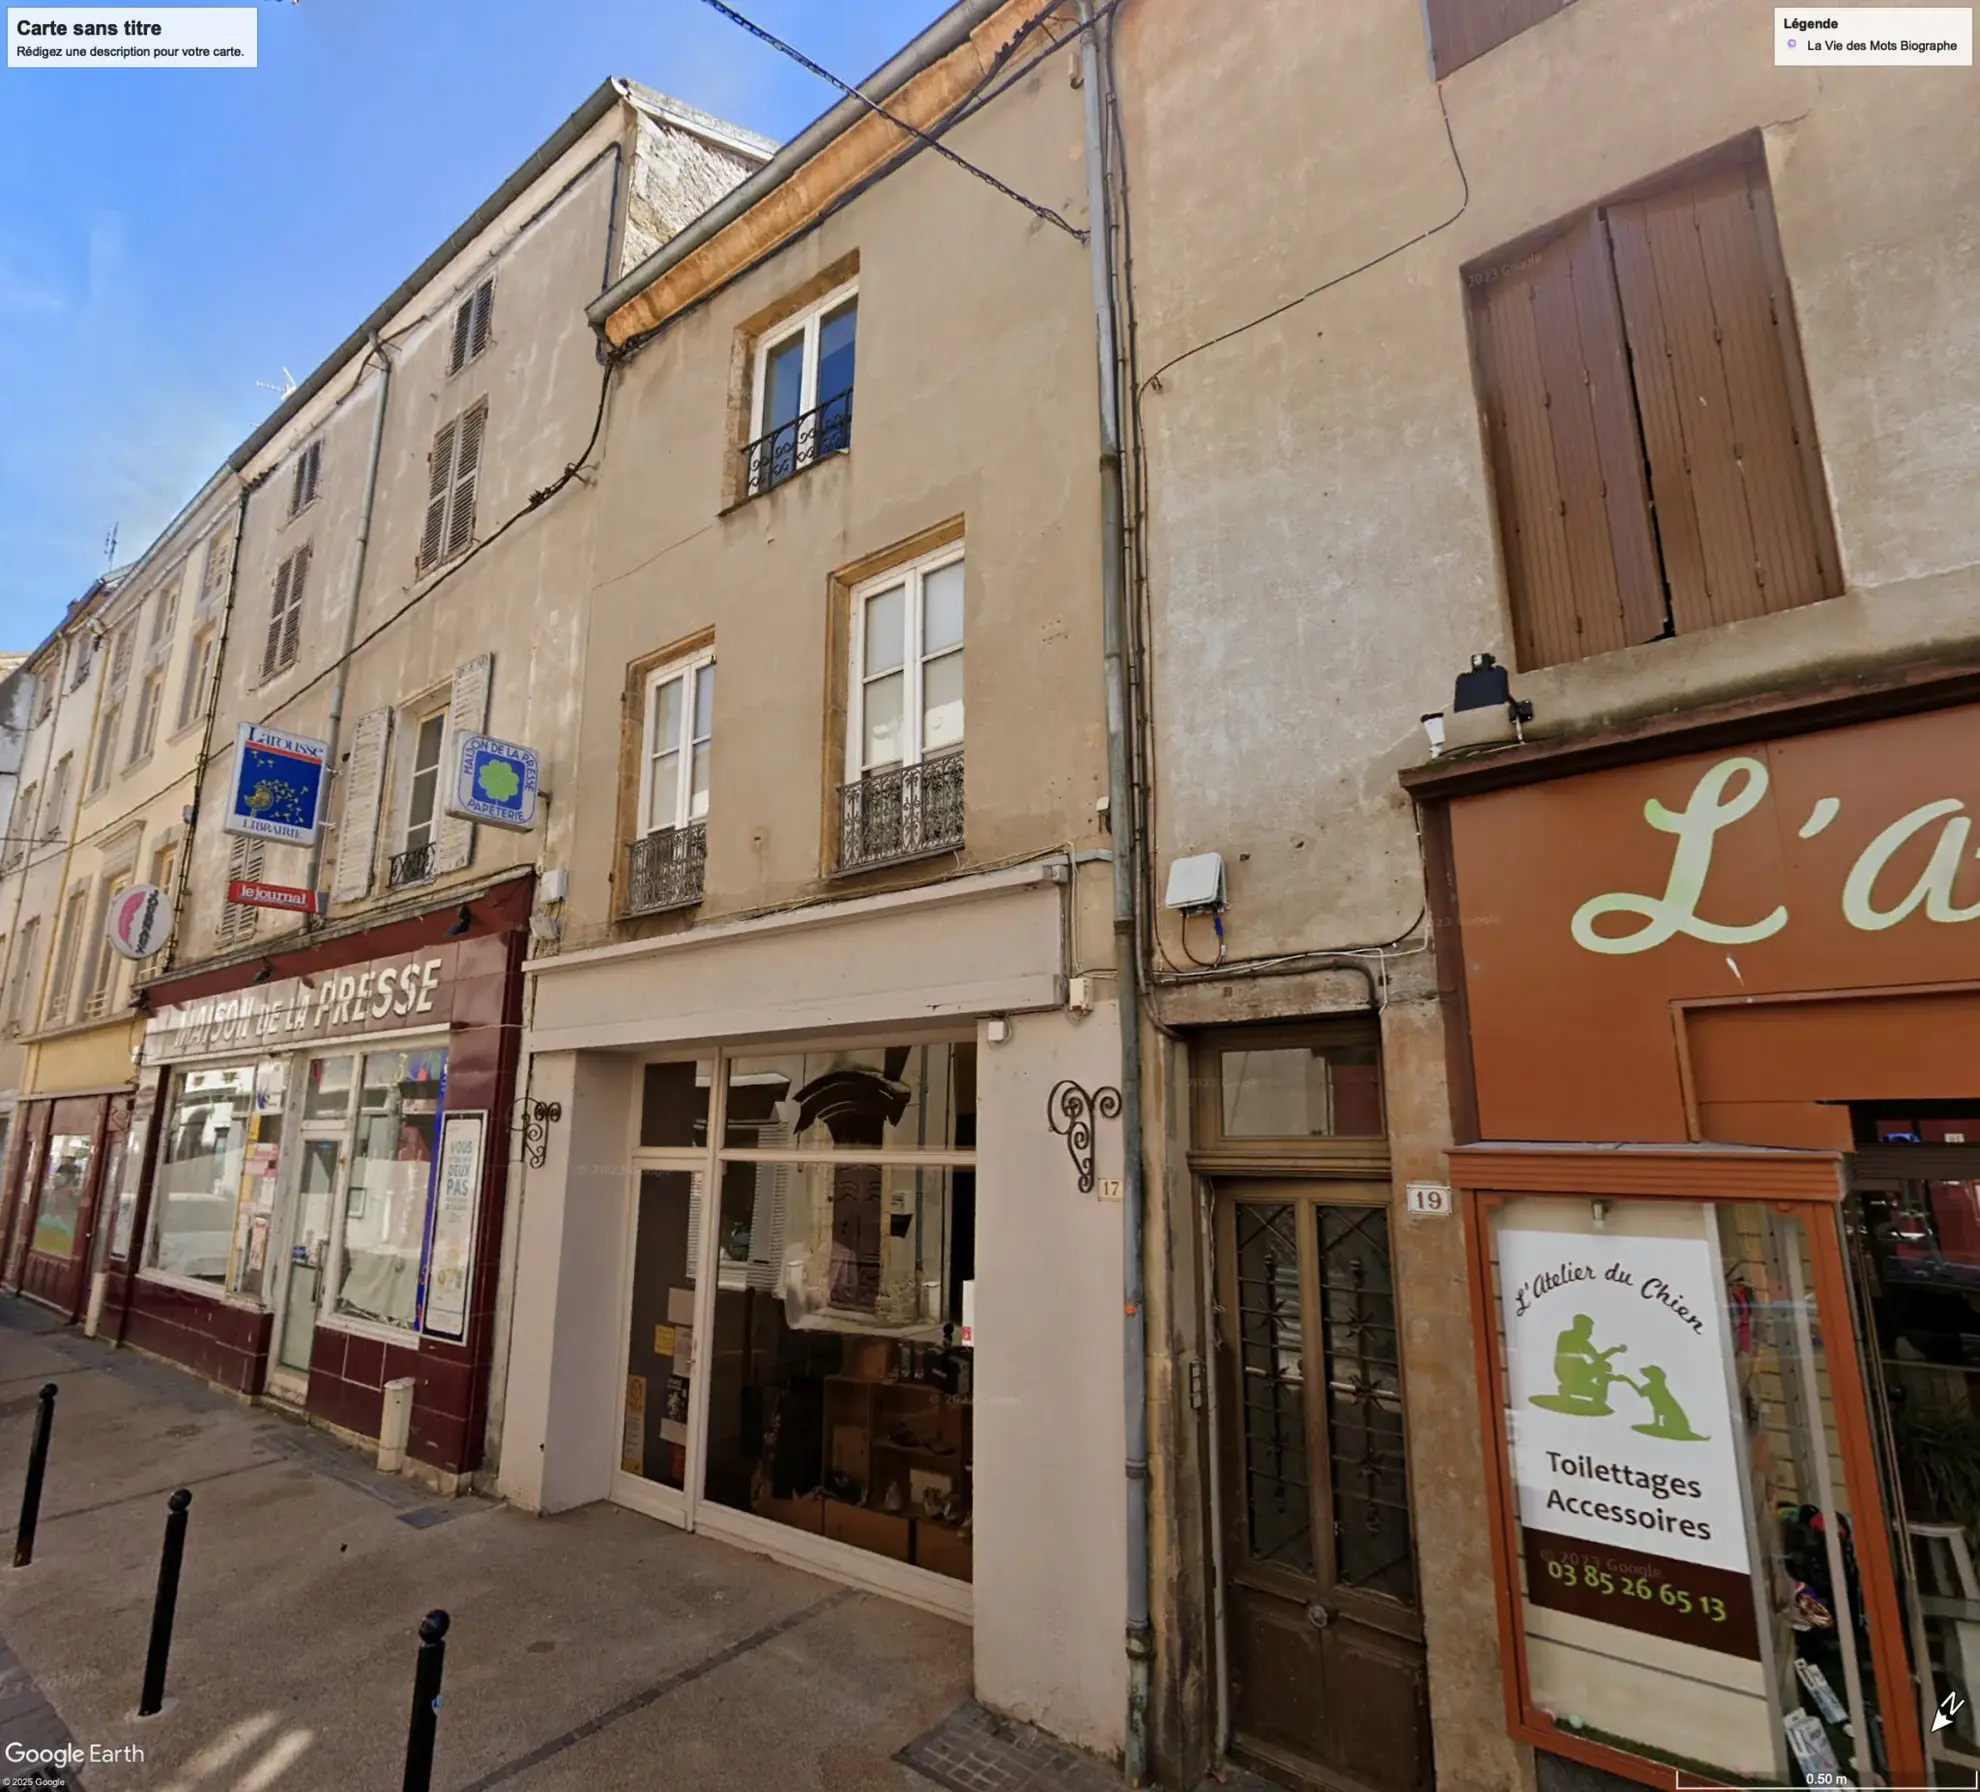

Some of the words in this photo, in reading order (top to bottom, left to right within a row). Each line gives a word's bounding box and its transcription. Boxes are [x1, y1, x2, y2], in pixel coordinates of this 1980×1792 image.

[247, 726, 324, 758] Larousse
[463, 740, 489, 775] MAISON
[490, 743, 504, 755] DE
[506, 747, 520, 759] LA
[521, 752, 538, 792] PRESSE
[243, 818, 302, 840] LIBRAIRIE
[1571, 757, 1980, 954] L'a
[174, 996, 255, 1050] MAISON
[257, 1004, 282, 1036] DE
[285, 995, 312, 1032] LA
[314, 958, 443, 1029] PRESSE
[450, 1140, 473, 1154] VOUS
[446, 1179, 469, 1197] PAS
[1103, 1180, 1119, 1196] 17
[1416, 1192, 1442, 1210] 19
[1515, 1262, 1597, 1317] L'Atelier
[1604, 1262, 1634, 1287] du
[1640, 1277, 1705, 1336] Chien
[1546, 1451, 1702, 1500] Toilettages
[1546, 1489, 1712, 1541] Accessoires
[1547, 1560, 1577, 1587] 03
[1583, 1564, 1615, 1594] 85
[1621, 1577, 1652, 1600] 26
[1660, 1584, 1693, 1613] 65
[1699, 1595, 1728, 1622] 13
